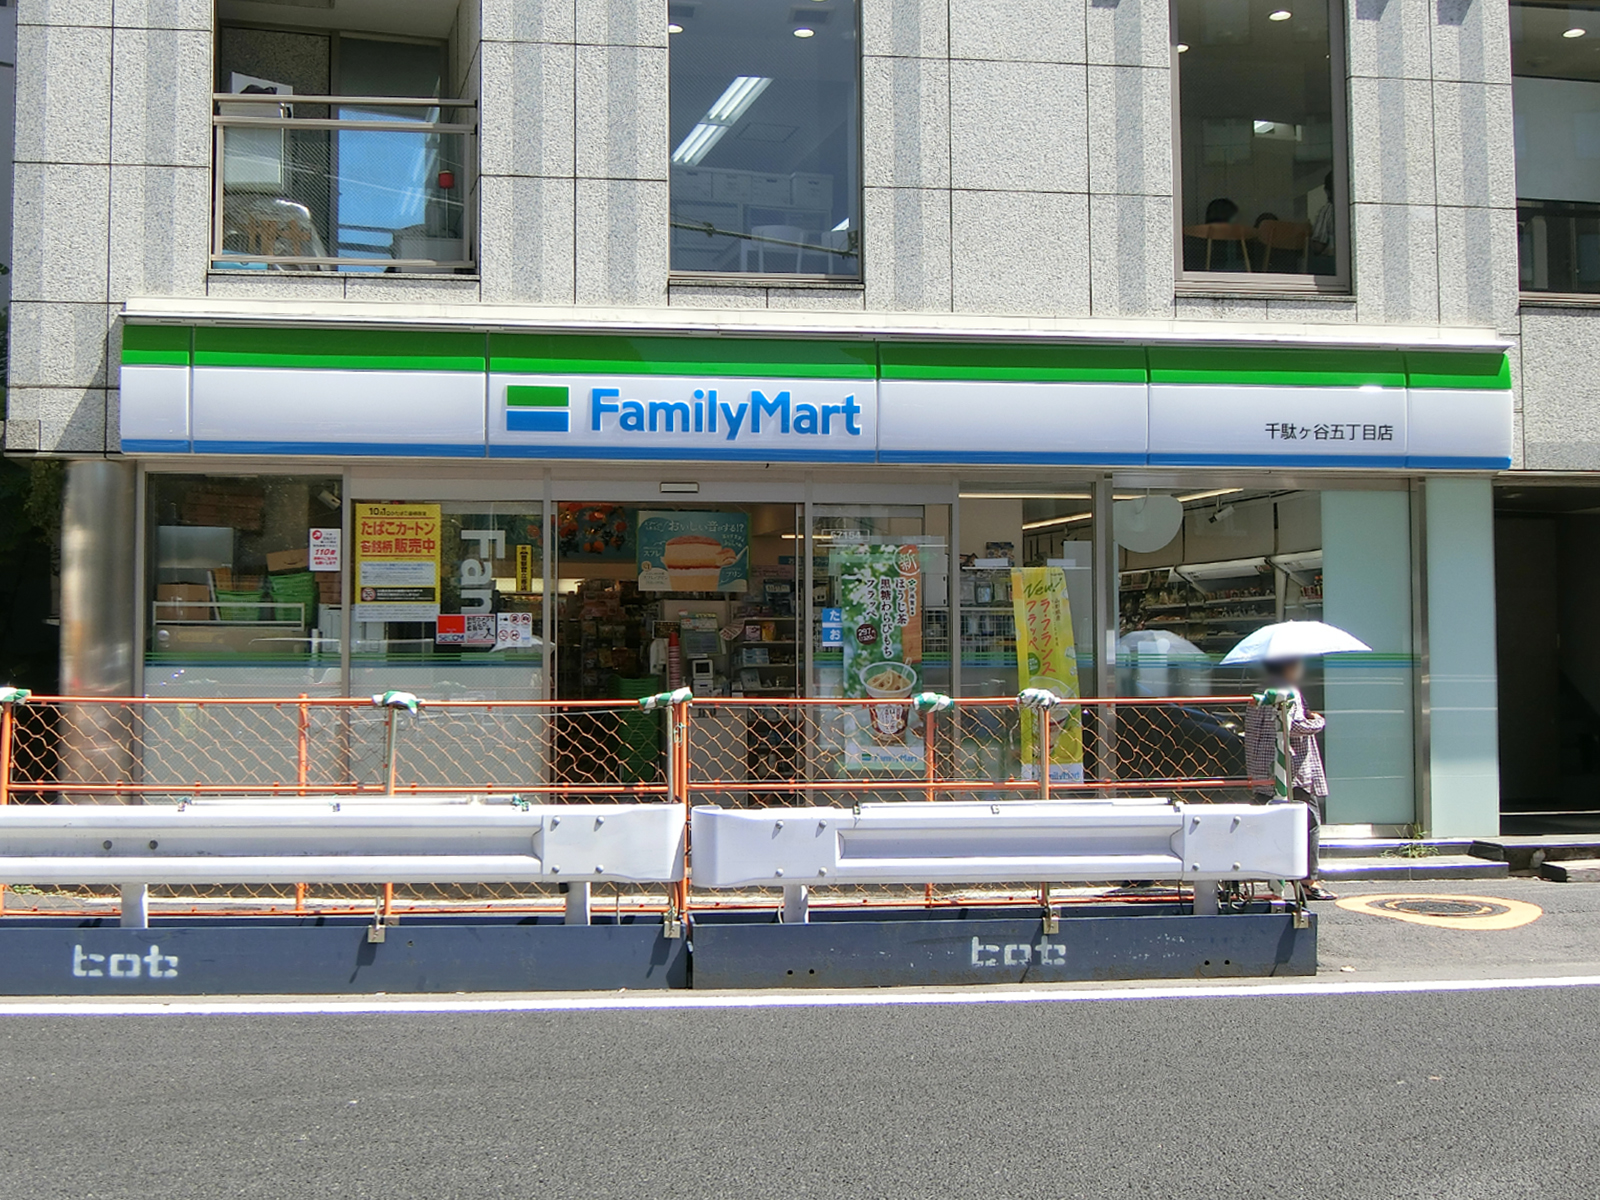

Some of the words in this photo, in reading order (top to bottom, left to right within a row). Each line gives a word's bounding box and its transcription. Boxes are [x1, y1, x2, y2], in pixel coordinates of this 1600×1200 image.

[591, 388, 861, 441] FamilyMart
[1265, 422, 1393, 441] 千駄ヶ谷五丁目店
[361, 520, 436, 536] たばこカートン
[898, 549, 917, 572] 新
[866, 579, 878, 618] フラッペ
[895, 578, 908, 625] ほうじ茶
[1024, 577, 1063, 598] New!
[880, 578, 893, 658] 黒糖わらびもち
[1026, 599, 1040, 651] フラッペ
[1040, 598, 1057, 676] ラ・フランス
[73, 944, 179, 977] tot
